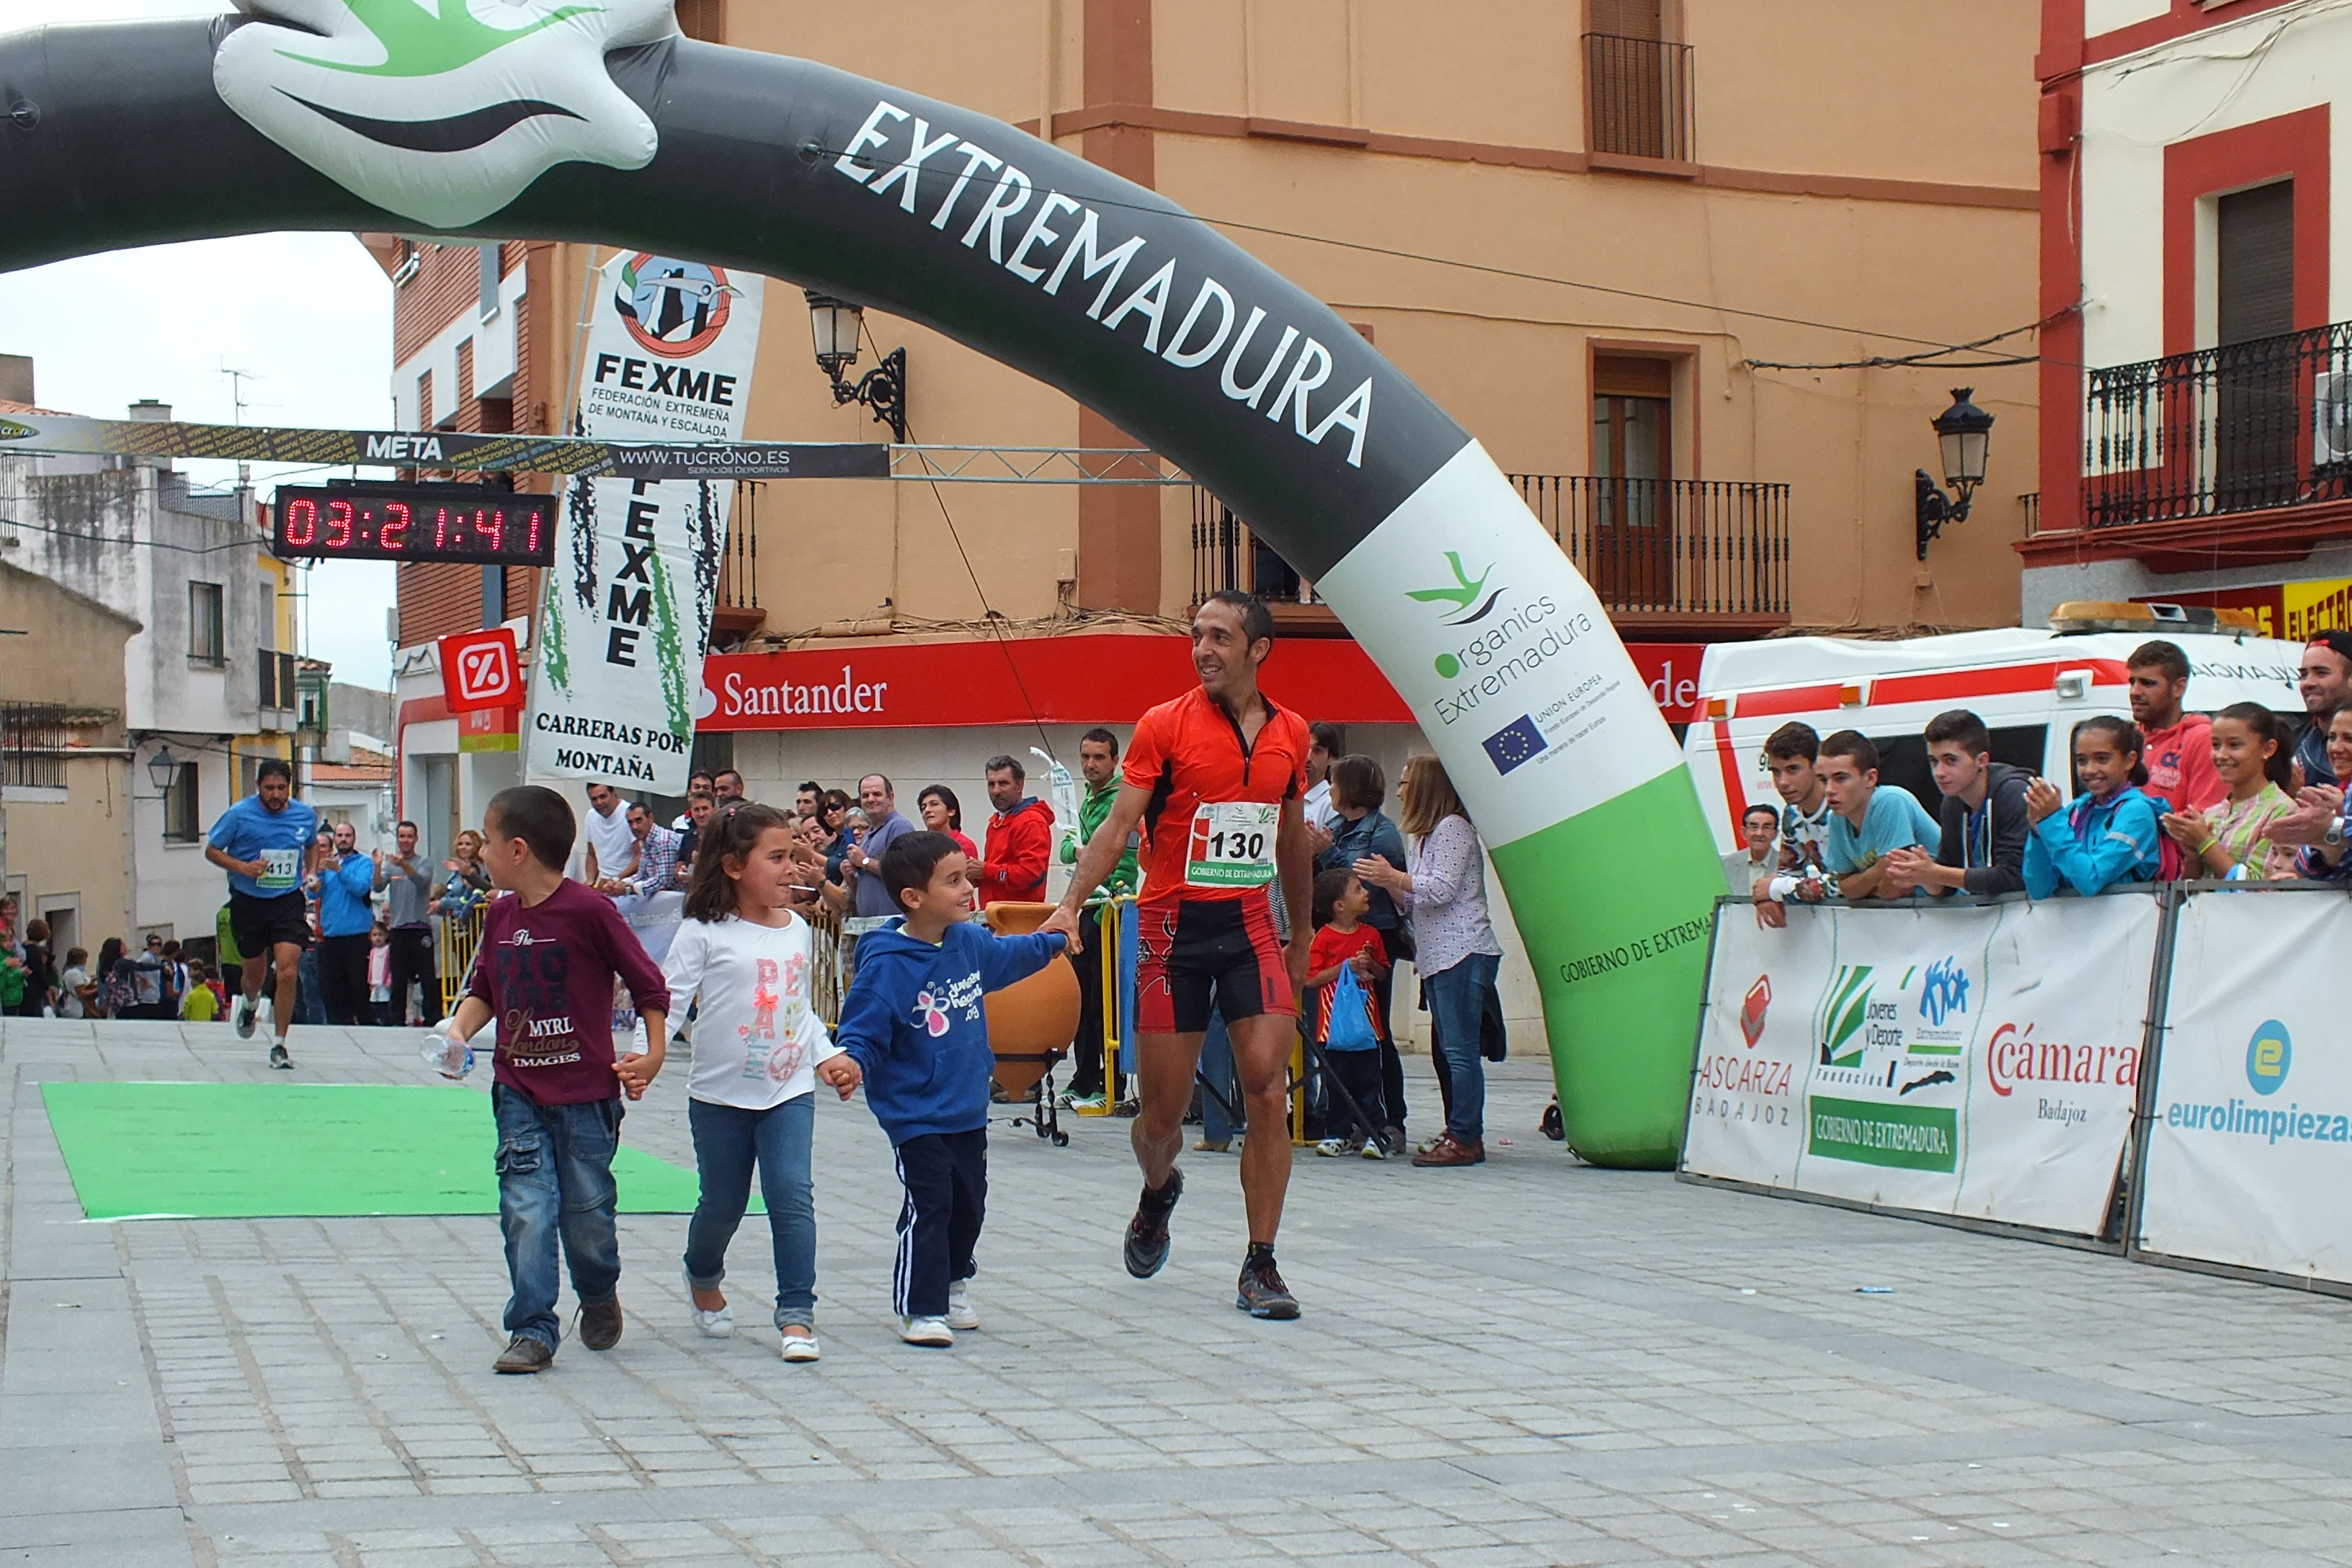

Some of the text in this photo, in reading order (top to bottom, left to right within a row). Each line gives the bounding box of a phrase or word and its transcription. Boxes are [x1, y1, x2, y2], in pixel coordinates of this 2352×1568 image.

[833, 101, 1372, 468] EXTREMADURA
[594, 352, 737, 406] FEXME
[589, 403, 727, 438] DE MONTAÑA Y ESCALADA
[592, 387, 730, 423] FEDERACIÓN EXTREMEÑA
[367, 435, 442, 460] META
[620, 447, 790, 465] WWW.TUCRONO.ES
[287, 499, 538, 551] 03:21:41
[1434, 613, 1592, 725] Extremadura
[724, 664, 887, 716] Santander
[1535, 674, 1603, 723] UNION EUROPEA
[536, 713, 685, 754] CARRERAS POR
[555, 749, 655, 782] MONTAÑA
[1211, 832, 1263, 859] 130
[266, 863, 292, 875] 413
[1191, 867, 1224, 877] GOBIERNO
[1560, 911, 1713, 983] GOBIERNO DE EXTREMA
[513, 1053, 581, 1067] IMAGES
[1698, 1056, 1792, 1097] ASCARZA
[1694, 1096, 1788, 1126] BADAJOZ
[2039, 1098, 2087, 1127] Badajoz
[2168, 1098, 2352, 1146] eurolimpieza
[1815, 1114, 1949, 1154] GOBIERNO DE EXTREMADURA
